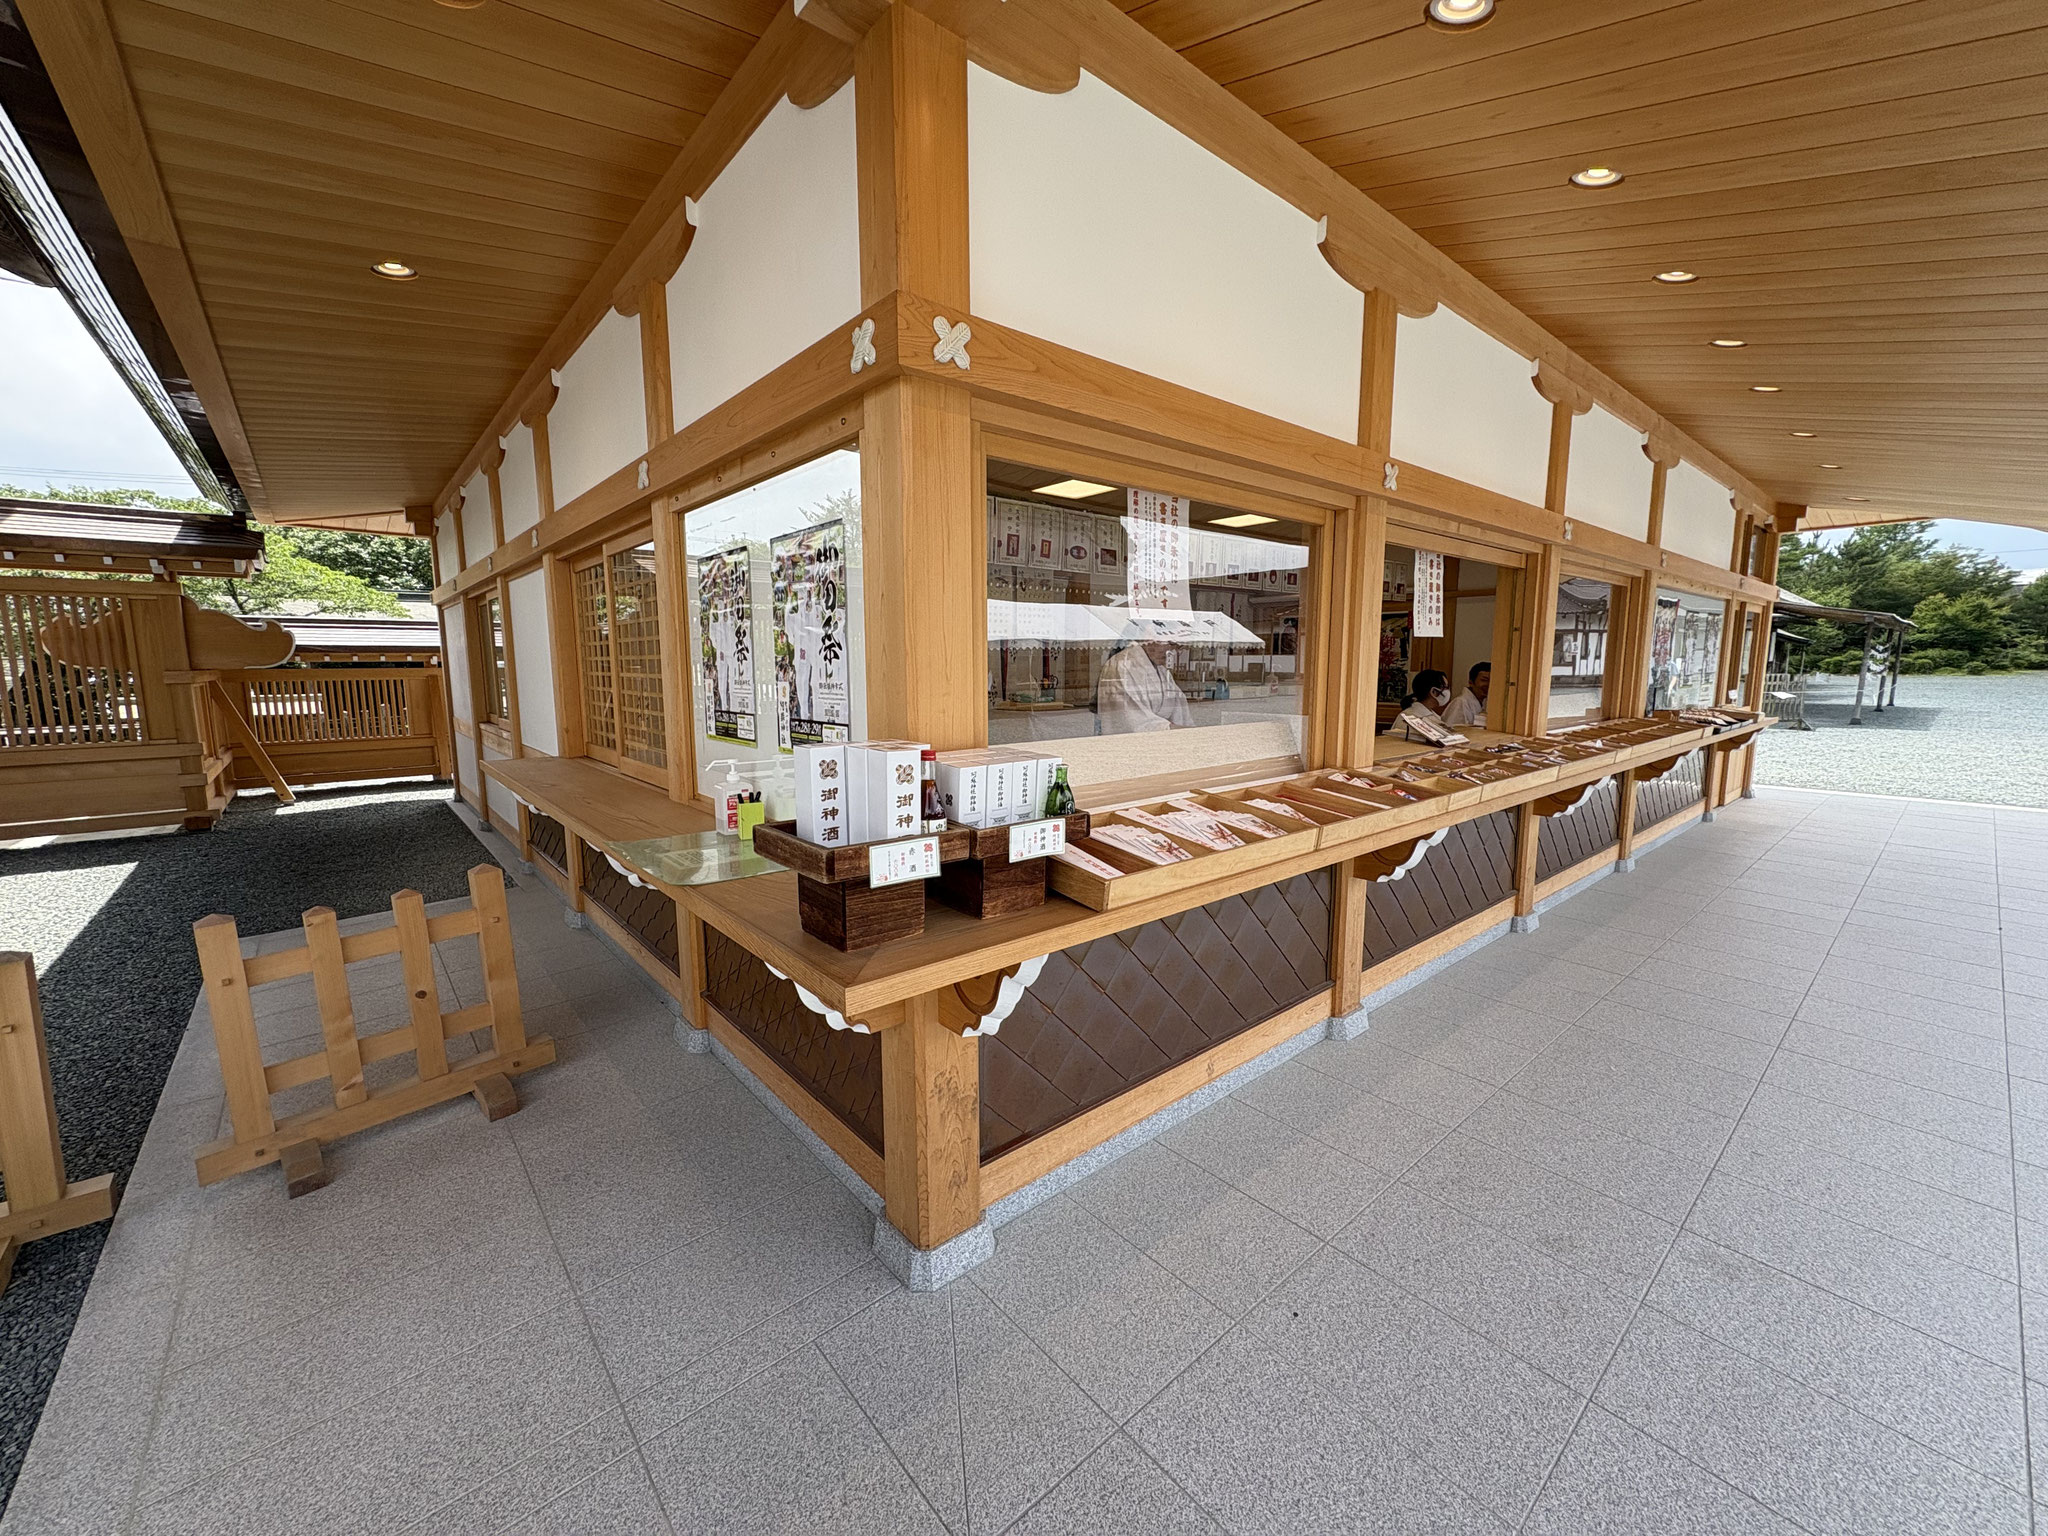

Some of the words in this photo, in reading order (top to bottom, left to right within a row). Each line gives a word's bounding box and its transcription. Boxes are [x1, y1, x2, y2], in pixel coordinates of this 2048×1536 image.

[820, 786, 840, 842] 御神酒
[895, 793, 914, 838] 御神
